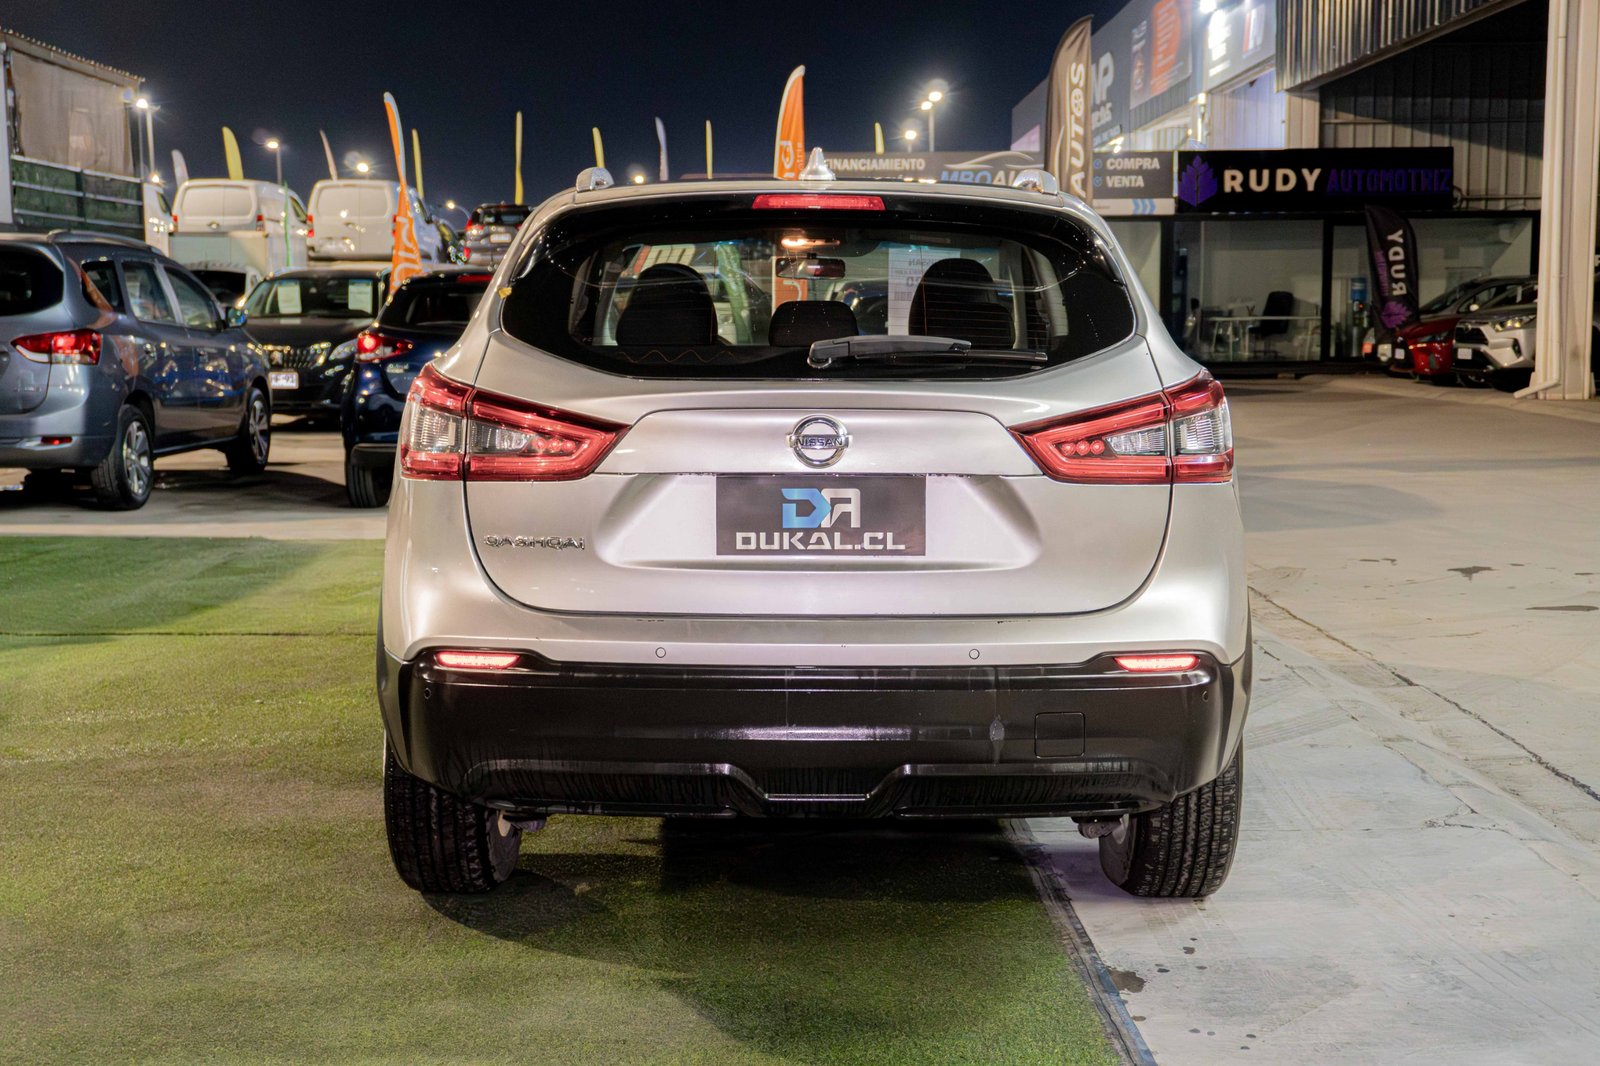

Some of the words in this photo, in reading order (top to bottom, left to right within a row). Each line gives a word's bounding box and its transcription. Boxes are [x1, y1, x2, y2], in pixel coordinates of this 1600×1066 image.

[1071, 62, 1087, 198] AUTOS
[1106, 157, 1161, 170] COMPRA
[1106, 175, 1145, 188] VENTA
[1223, 167, 1322, 193] RUDY
[1326, 167, 1451, 193] AUTOMOTRIZ
[1387, 228, 1408, 296] RUDY
[796, 437, 844, 447] NISSAN
[483, 534, 585, 551] QASHQAI
[735, 532, 906, 551] DUKAL.CL
